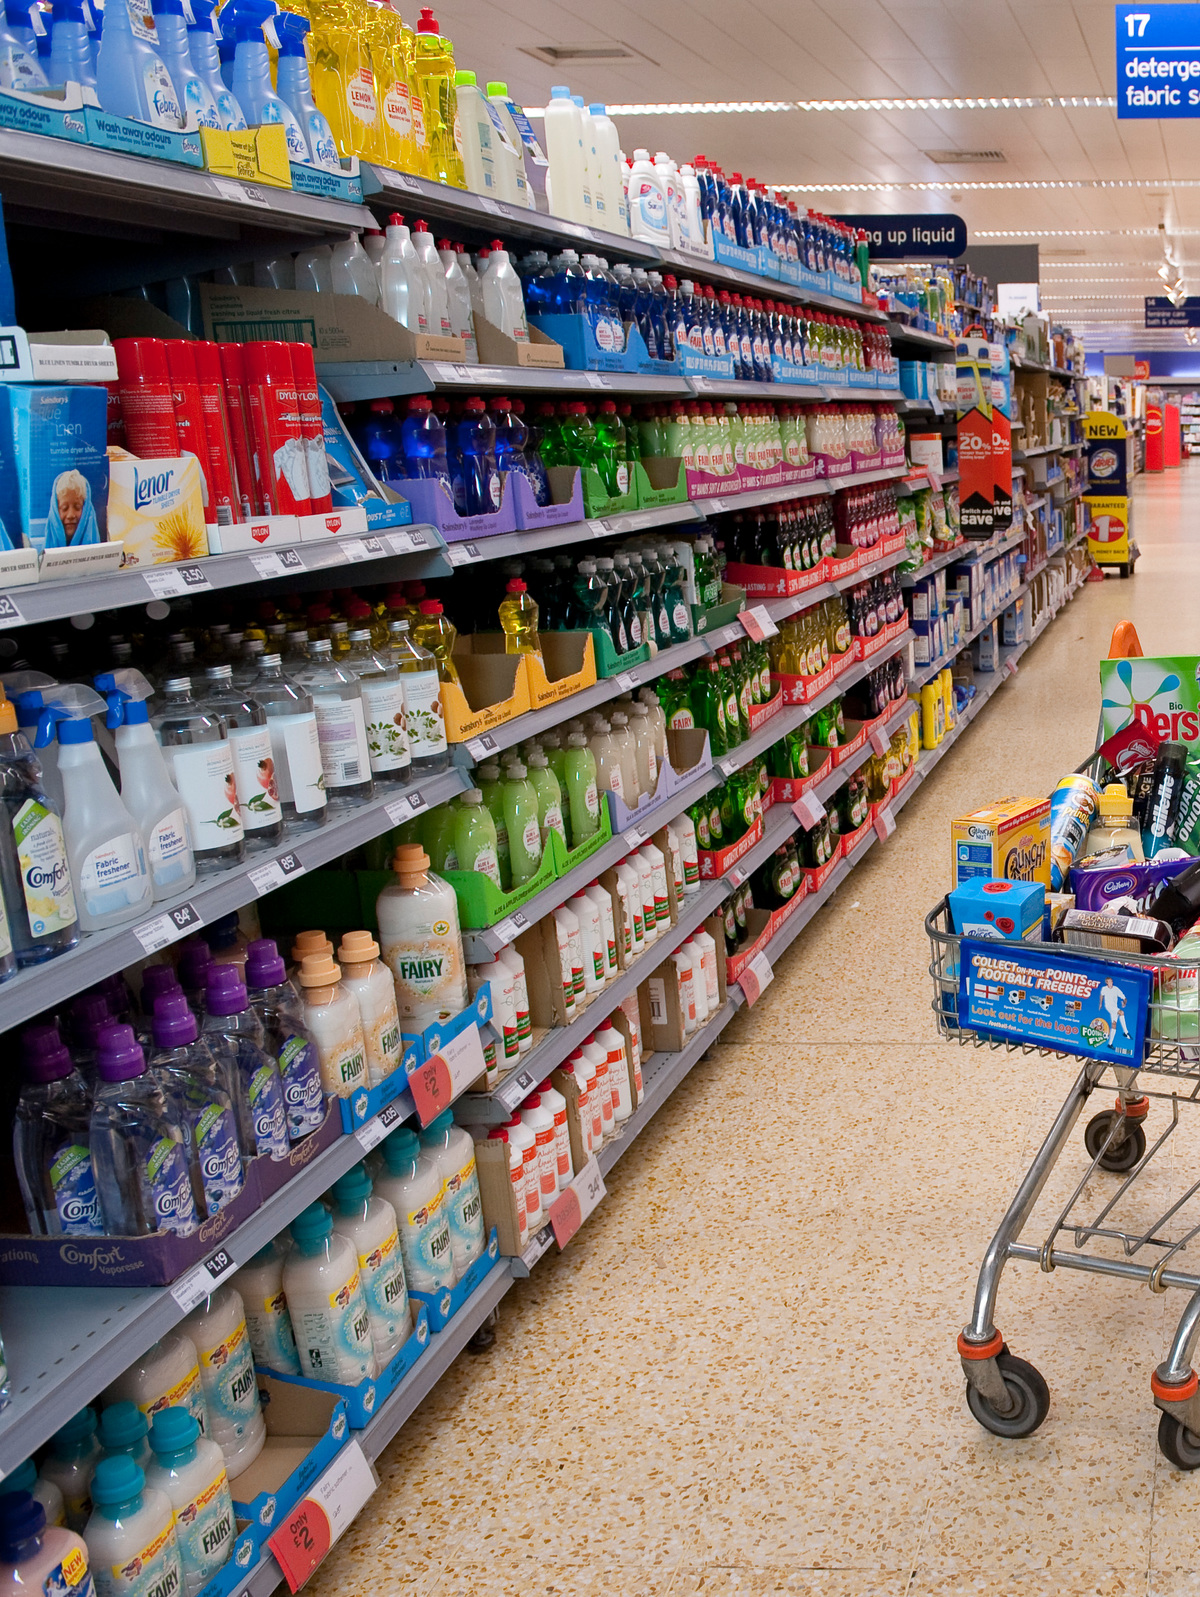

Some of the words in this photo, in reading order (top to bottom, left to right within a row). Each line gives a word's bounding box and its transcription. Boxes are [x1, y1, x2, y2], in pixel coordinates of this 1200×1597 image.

[1125, 14, 1150, 37] 17
[351, 92, 371, 103] LEMON
[1126, 85, 1181, 106] fabric
[19, 107, 51, 123] odours
[387, 104, 407, 116] LEMON
[96, 119, 121, 135] Wash
[122, 125, 144, 140] away
[145, 126, 172, 144] odours
[888, 231, 907, 246] up
[912, 226, 955, 244] liquid
[957, 386, 975, 394] Rinse
[1089, 425, 1118, 436] NEW
[959, 436, 991, 450] 20%
[1093, 458, 1115, 468] ARIEL
[134, 467, 174, 511] Lenor
[326, 518, 341, 527] DYLON
[961, 514, 993, 525] save
[1095, 515, 1110, 542] 1
[252, 527, 270, 536] DYLON
[1168, 701, 1183, 711] Bio
[673, 716, 692, 729] FAIRY
[1151, 775, 1175, 838] Gillette
[159, 831, 176, 842] Fabric
[968, 825, 995, 838] CRUNCHY
[160, 836, 183, 850] freshener
[96, 857, 119, 870] Fabric
[1004, 838, 1047, 880] CRUNCHY
[27, 859, 68, 891] Comfort
[97, 862, 130, 878] freshener
[1104, 878, 1133, 894] Cadbury
[174, 907, 191, 925] 84p
[1077, 913, 1119, 924] MAGNUM
[400, 958, 444, 980] FAIRY
[972, 954, 1018, 973] COLLECT
[1017, 967, 1045, 978] ON-PACK
[1046, 969, 1089, 986] POINTS
[1087, 980, 1101, 988] GET
[977, 967, 1034, 987] FOOTBALL
[1036, 978, 1093, 999] FREEBIES
[971, 1004, 997, 1018] Look
[998, 1010, 1016, 1022] out
[1017, 1013, 1033, 1025] for
[1034, 1017, 1052, 1030] the
[1054, 1019, 1080, 1035] logo
[340, 1052, 366, 1083] FAIRY
[423, 1065, 437, 1080] Only
[286, 1073, 321, 1104] Comfort
[425, 1077, 440, 1097] £2
[204, 1141, 239, 1177] Comfort
[157, 1178, 192, 1214] Comfort
[556, 1195, 579, 1225] basics
[199, 1213, 228, 1243] Comfort
[60, 1243, 125, 1272] Comfort
[206, 1253, 229, 1273] £1.19
[99, 1260, 145, 1277] Vaporesse
[202, 1512, 231, 1554] FAIRY
[289, 1512, 308, 1535] Only
[293, 1526, 315, 1551] £2
[63, 1550, 83, 1578] NEW
